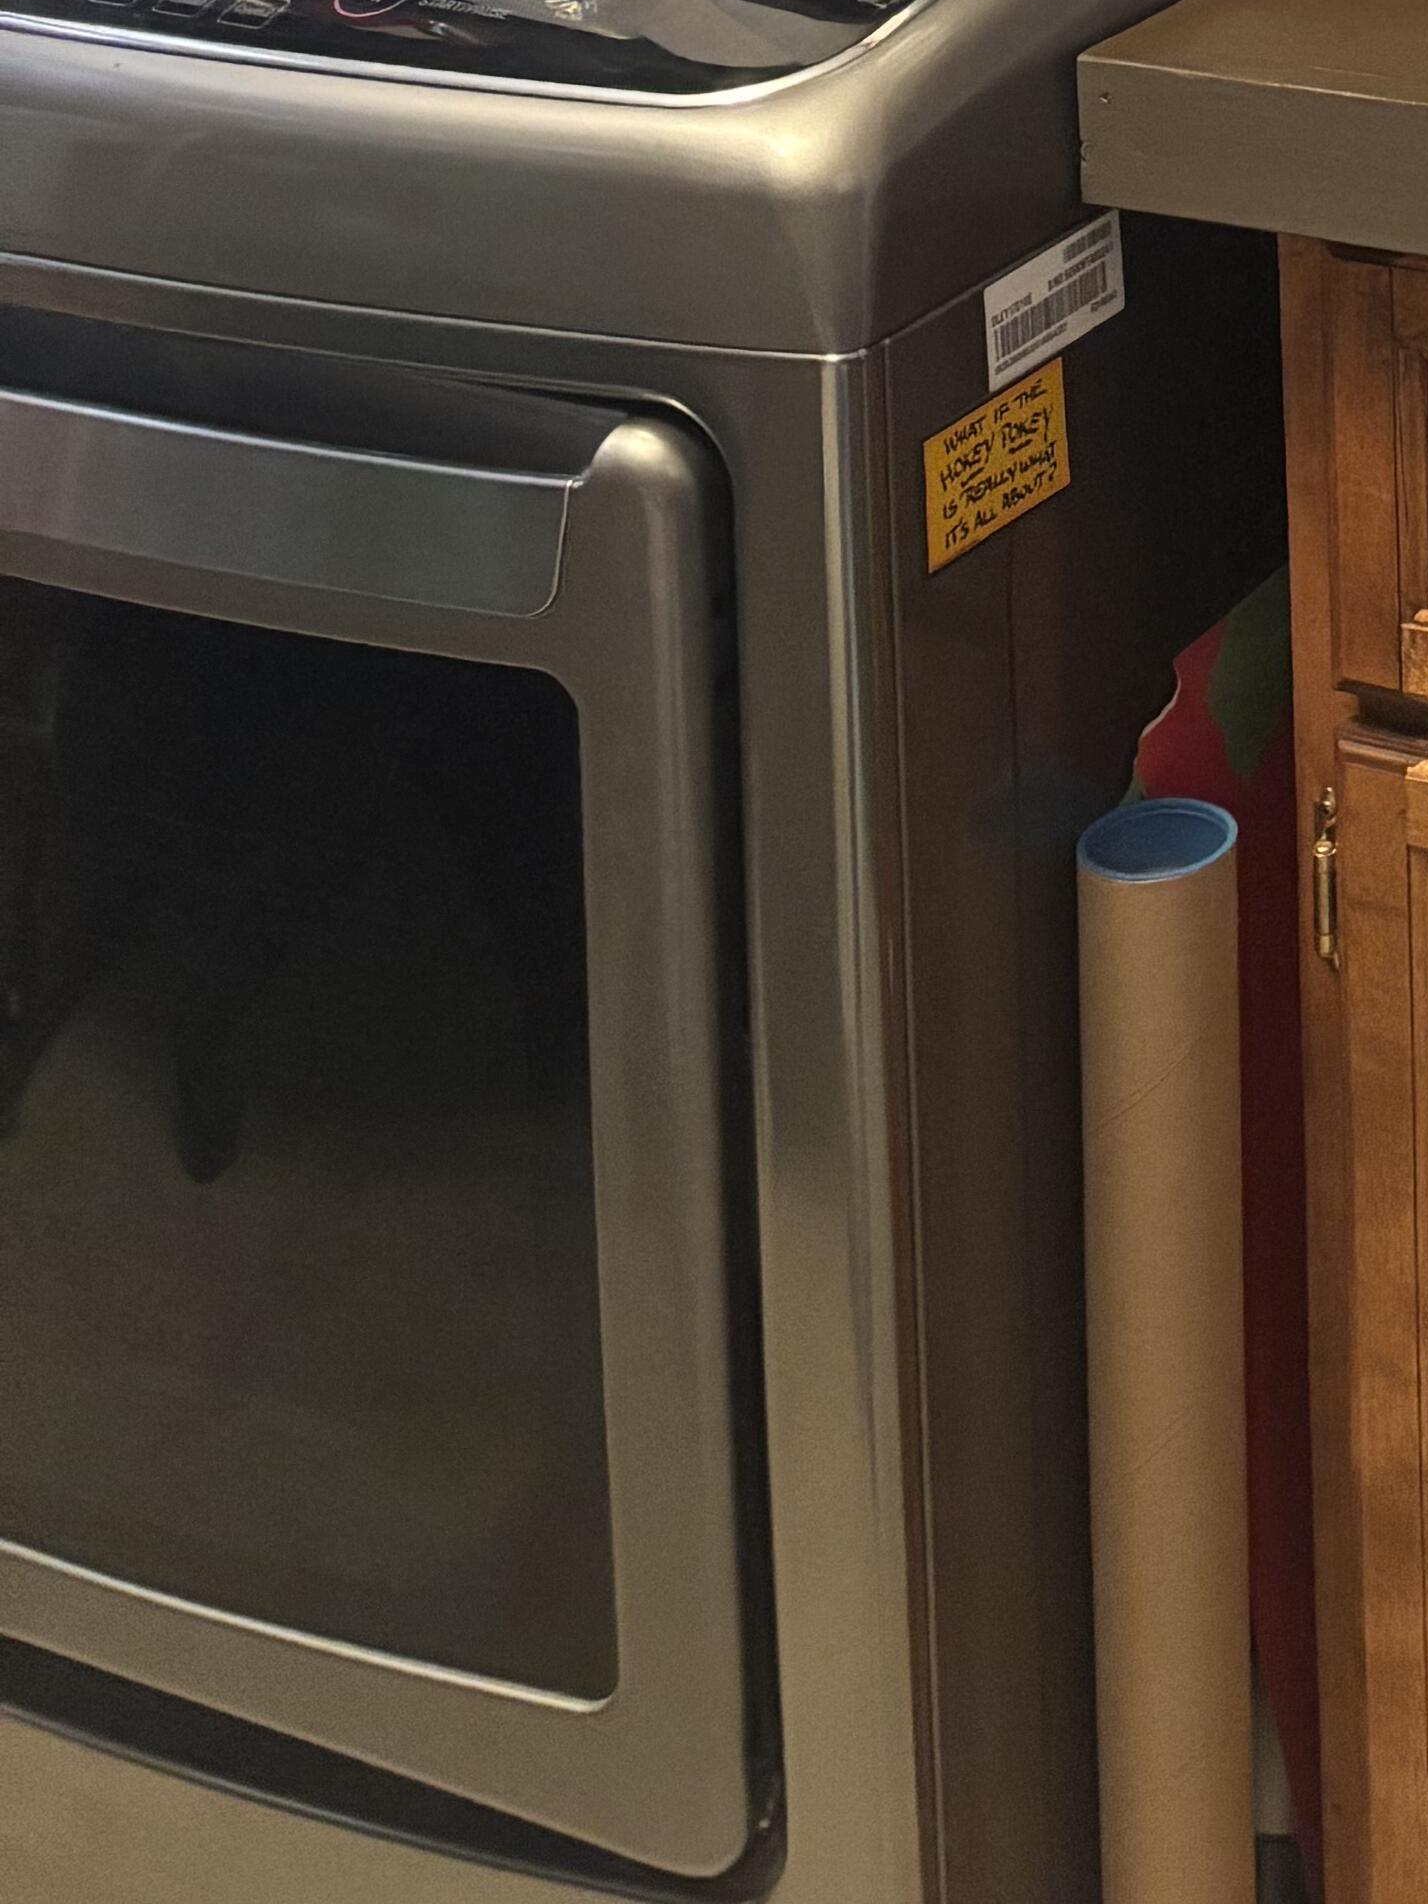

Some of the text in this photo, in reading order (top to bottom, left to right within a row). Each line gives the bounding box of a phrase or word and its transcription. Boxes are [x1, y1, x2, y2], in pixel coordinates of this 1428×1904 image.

[943, 378, 1048, 456] WHAT IF THE
[939, 431, 995, 492] HOKEY
[942, 499, 958, 520] IS
[944, 518, 970, 550] IT'S
[973, 507, 998, 533] ALL
